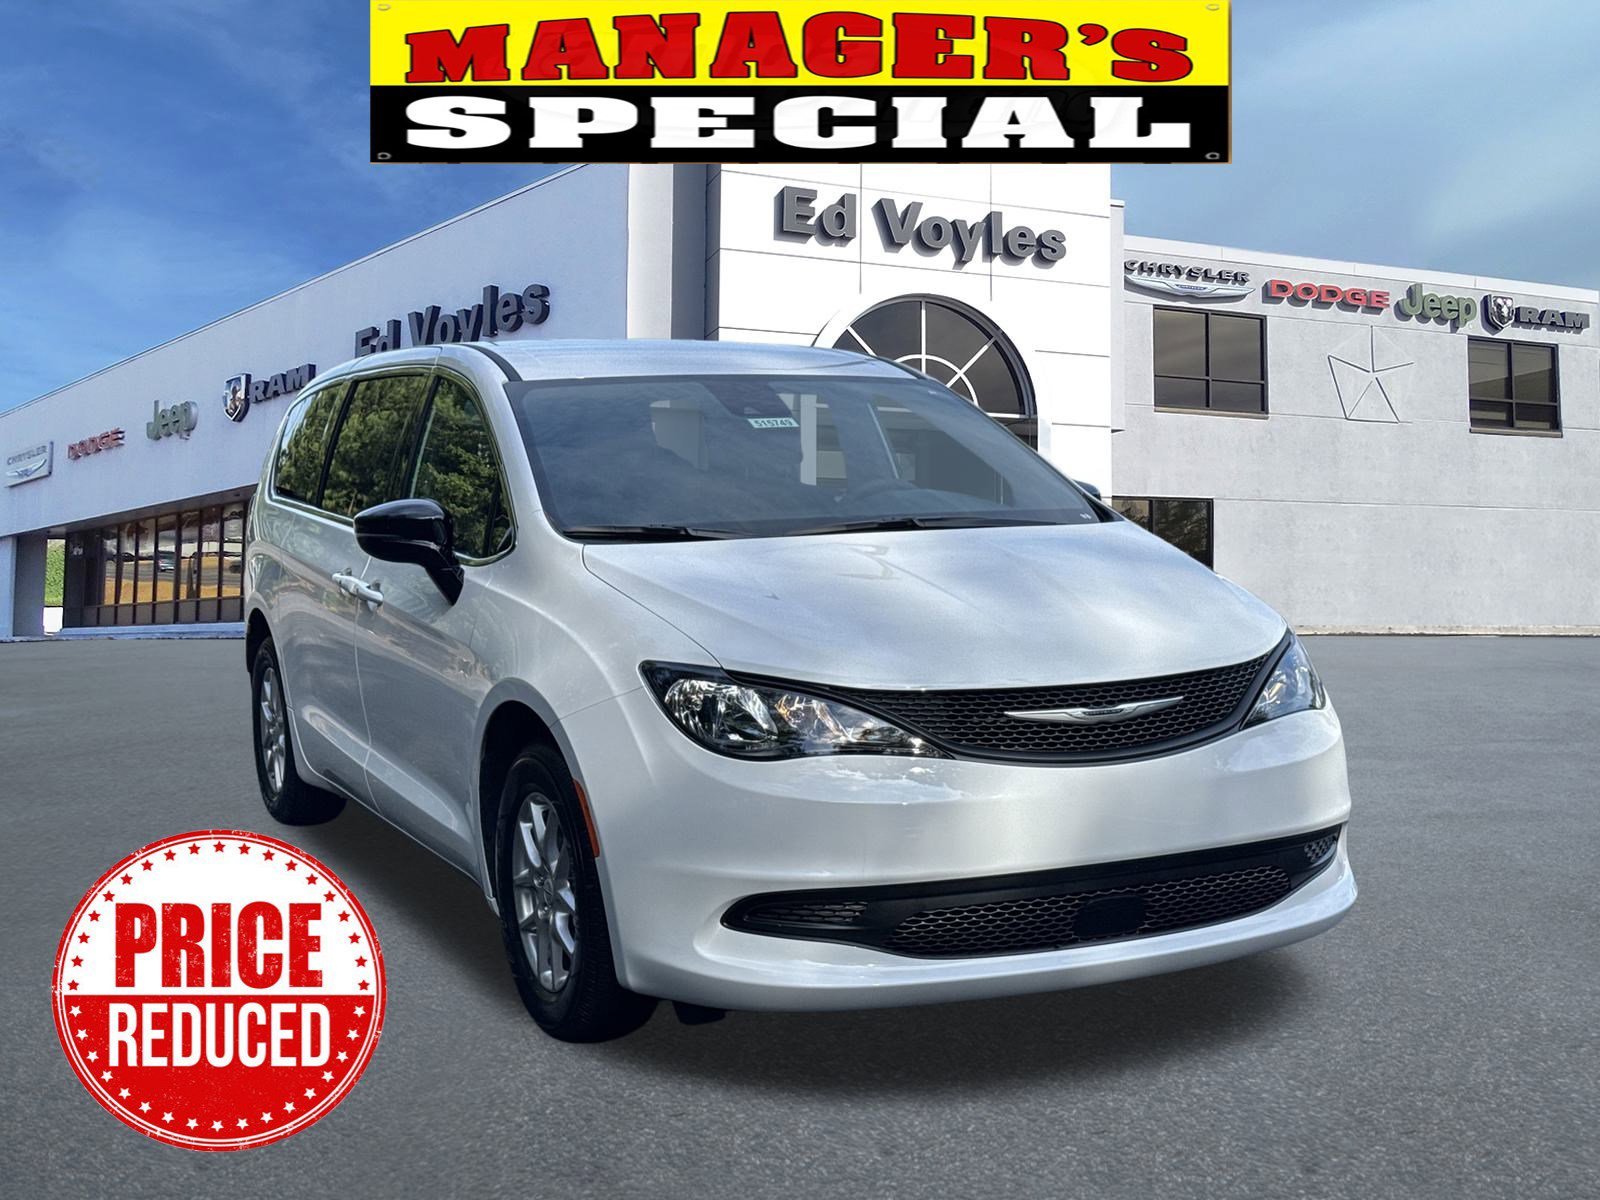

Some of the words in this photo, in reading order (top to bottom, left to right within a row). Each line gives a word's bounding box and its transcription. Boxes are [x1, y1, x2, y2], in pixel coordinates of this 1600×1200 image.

[775, 186, 856, 243] Ed
[872, 198, 1067, 269] Voyles
[1124, 259, 1250, 286] CHRYSLER
[408, 284, 550, 346] Voyles
[1264, 280, 1390, 314] DODGE
[1398, 283, 1477, 332] Jeep
[1513, 306, 1590, 334] RAM
[250, 363, 316, 403] RAM
[147, 400, 199, 440] Jeep
[7, 445, 48, 465] CHRYSLER
[68, 428, 126, 460] DODGE
